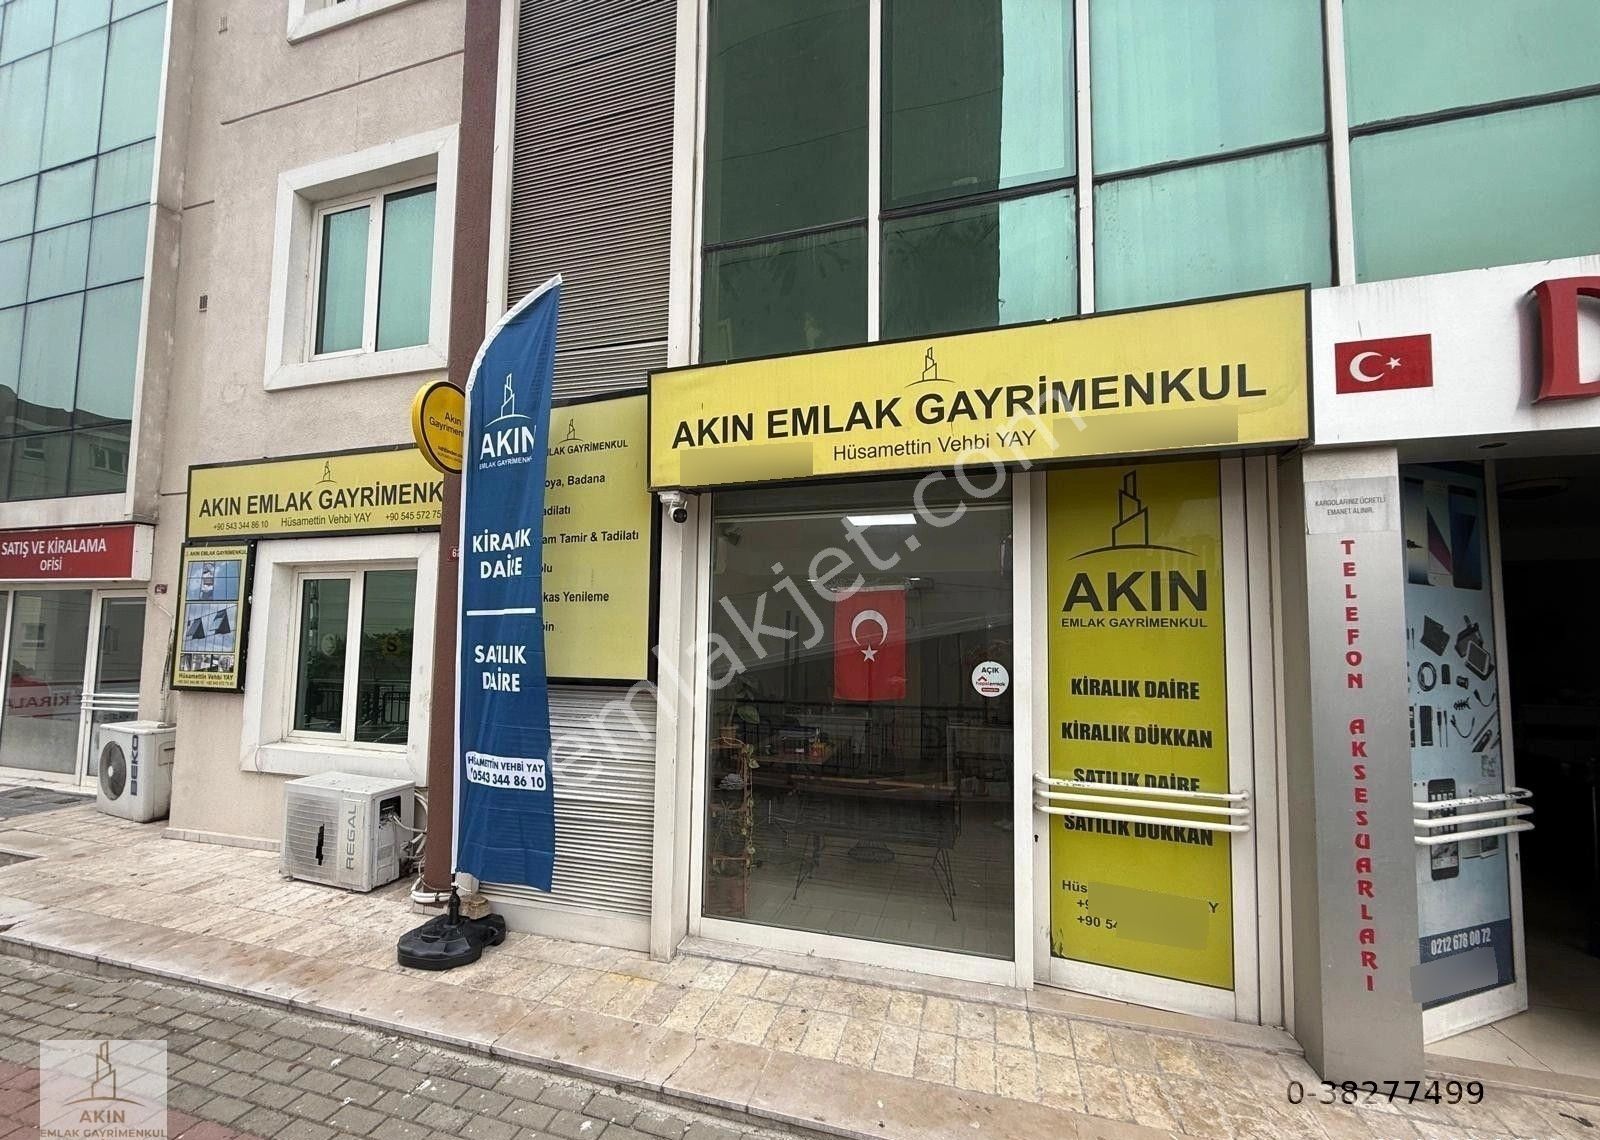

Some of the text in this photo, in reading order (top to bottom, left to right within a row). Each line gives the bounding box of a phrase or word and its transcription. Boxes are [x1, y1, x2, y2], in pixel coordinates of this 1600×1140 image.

[672, 363, 1267, 449] AKIN EMLAK GAYRİMENKUL
[480, 425, 536, 460] AKIN
[567, 440, 628, 455] GAYRİMENKUL
[834, 429, 1036, 461] Hüsamettin Vehbi YAY
[544, 474, 605, 489] oya, Badana
[199, 481, 444, 518] AKIN EMLAK GAYRİMENK
[281, 512, 372, 527] Hüsamettin Vehbi YAY
[385, 512, 399, 521] +90
[401, 511, 415, 520] 545
[416, 510, 430, 519] 572
[213, 523, 224, 531] +90
[226, 522, 238, 530] 543
[261, 520, 269, 528] 10
[542, 530, 639, 545] am Tamir & Tadilatı
[1, 536, 107, 558] SATIŞ VE KİRALAMA
[39, 557, 63, 571] OFİSİ
[543, 591, 609, 602] kas Yenileme
[1062, 569, 1208, 612] AKIN
[1061, 616, 1208, 628] EMLAK GAYRİMENKUL
[1341, 540, 1364, 689] TELEFON
[982, 667, 999, 675] AÇIK
[1071, 676, 1200, 700] KİRALIK DAİRE
[1061, 720, 1213, 748] KİRALIK DÜKKAN
[500, 762, 524, 772] VEHBİ
[526, 764, 544, 773] YAY
[492, 774, 510, 786] 344
[514, 776, 527, 787] 86
[531, 777, 544, 788] 10
[345, 803, 357, 871] REGAL
[1349, 718, 1379, 992] AKSESUARLARI
[1077, 915, 1100, 928] +90
[1430, 936, 1451, 956] 0212
[1481, 927, 1491, 943] 72
